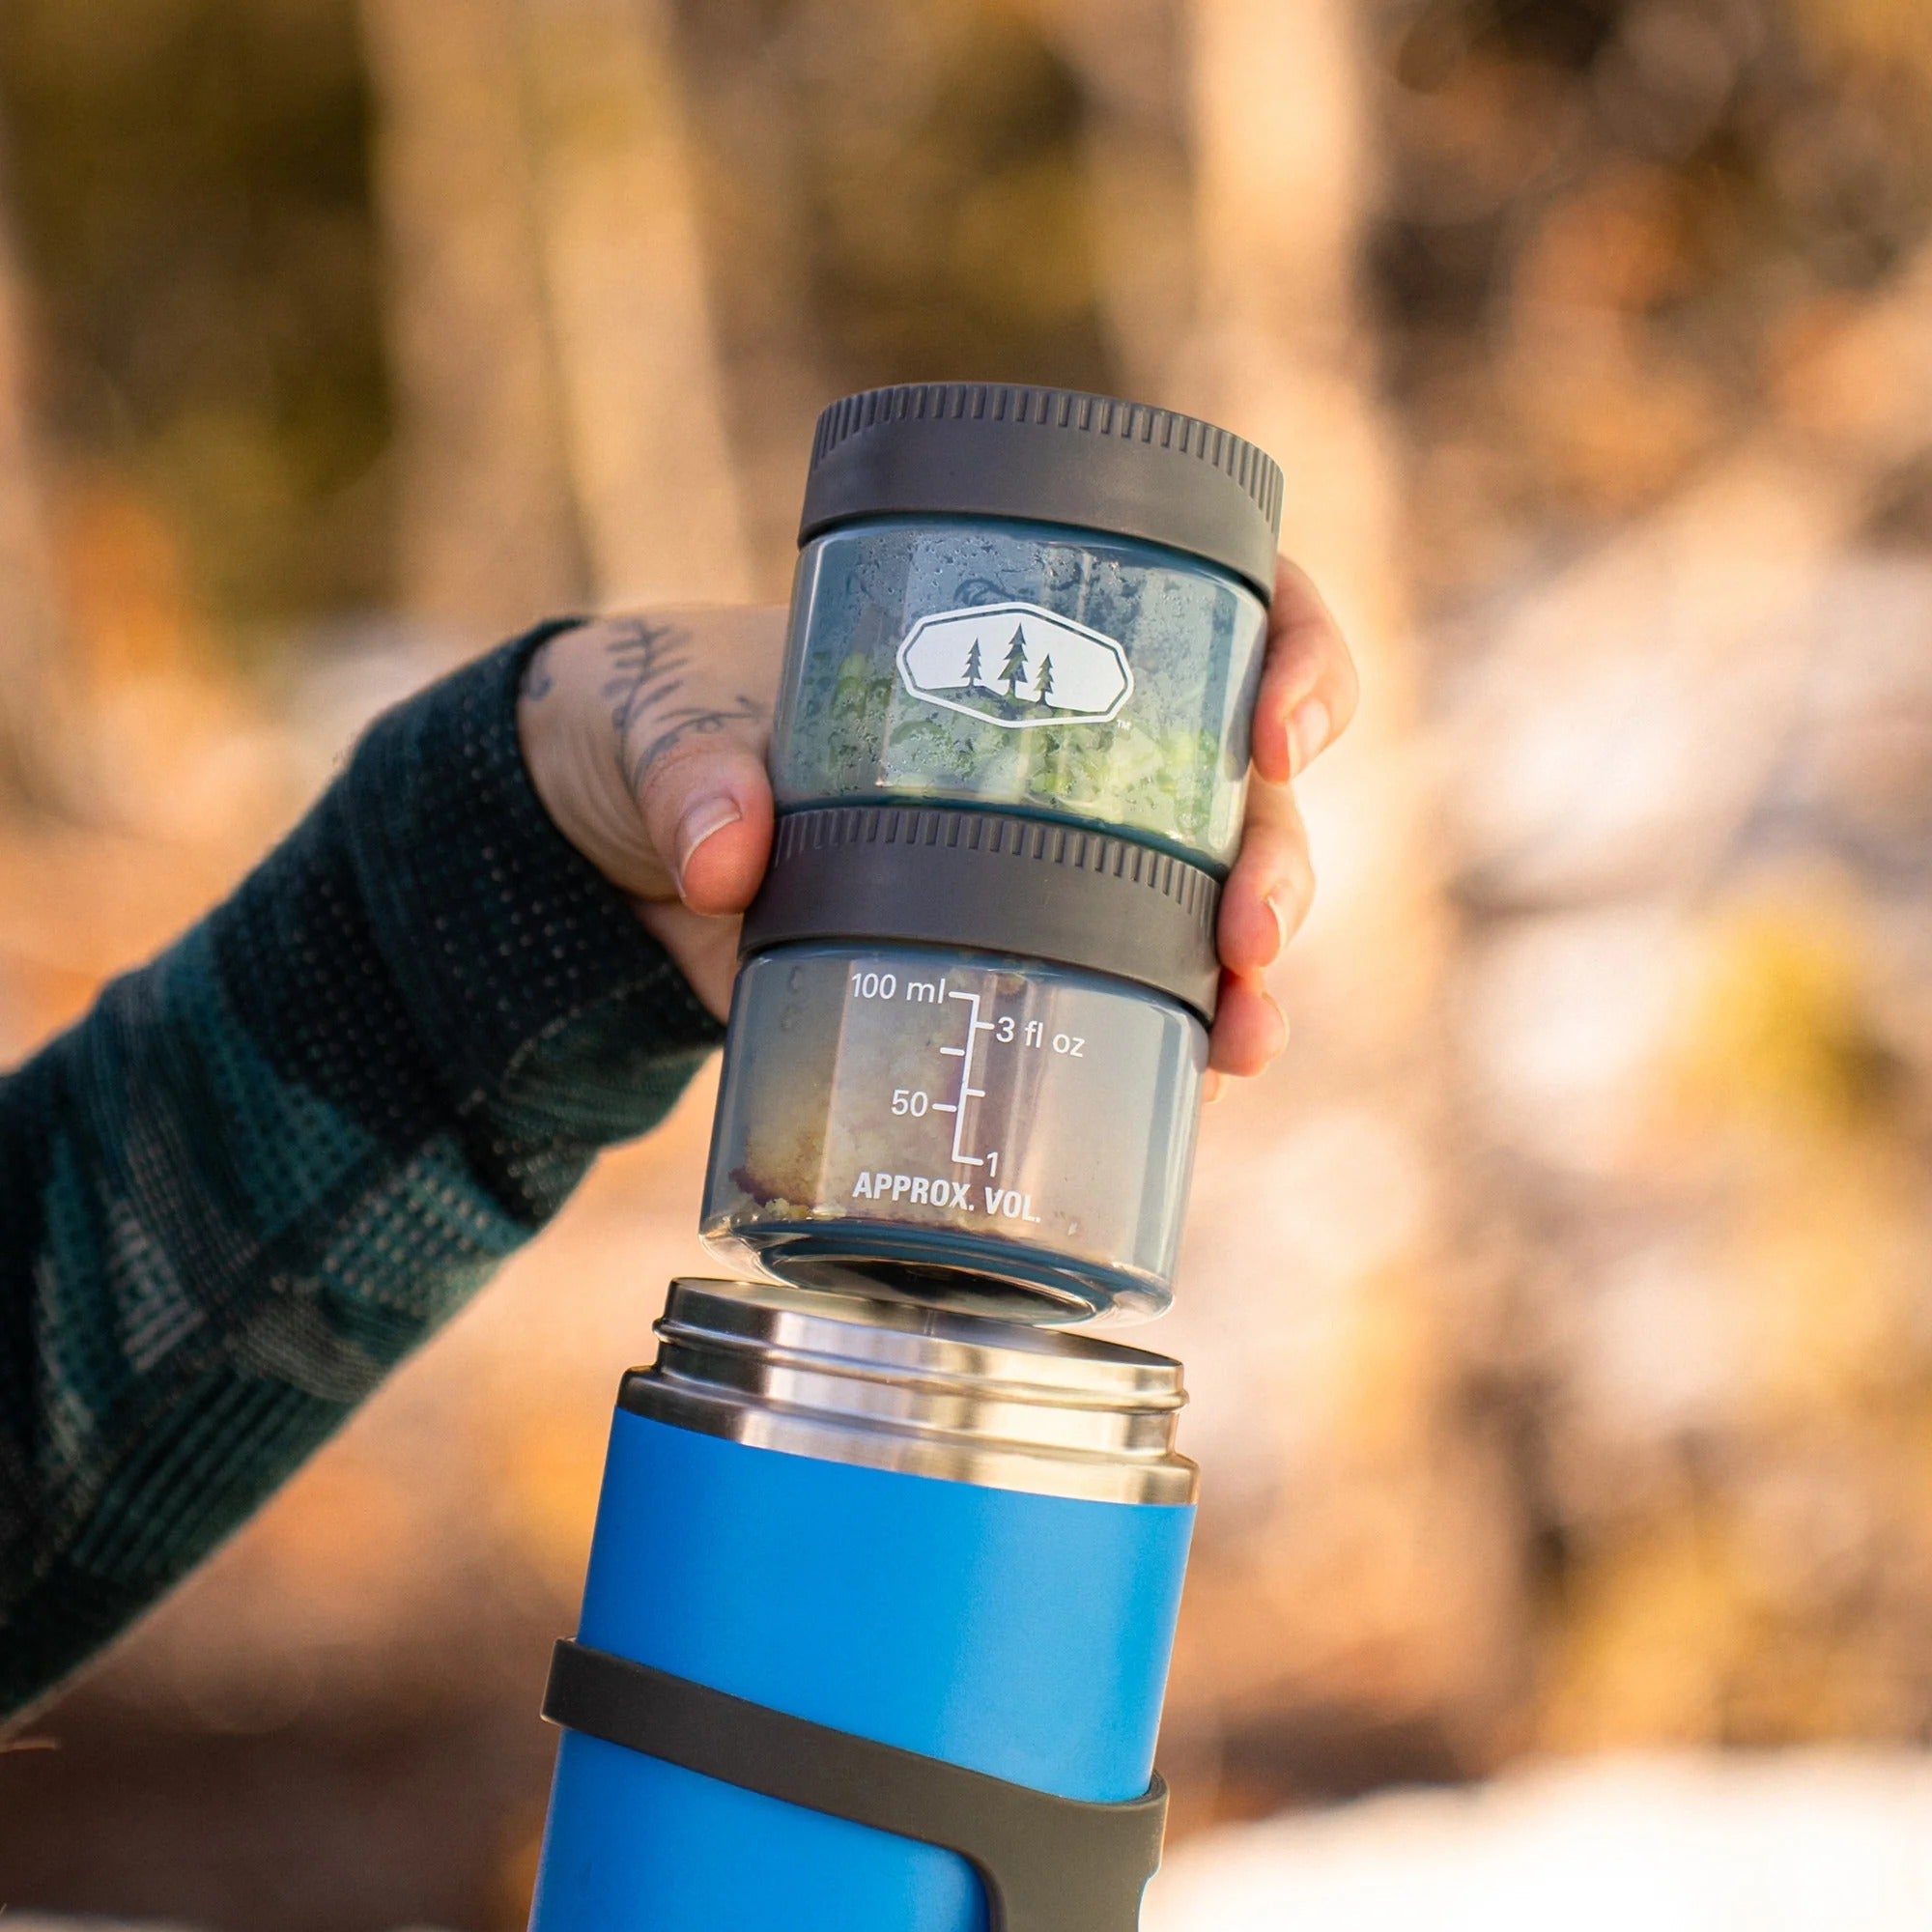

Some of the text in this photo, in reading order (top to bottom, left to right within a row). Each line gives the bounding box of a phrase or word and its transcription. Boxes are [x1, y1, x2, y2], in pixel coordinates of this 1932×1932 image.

[851, 973, 946, 1004] 100 ml
[996, 1016, 1086, 1058] 3 fl oz
[891, 1090, 928, 1118] 50
[986, 1151, 998, 1178] 1
[852, 1172, 1041, 1223] APPROX. VOL.
